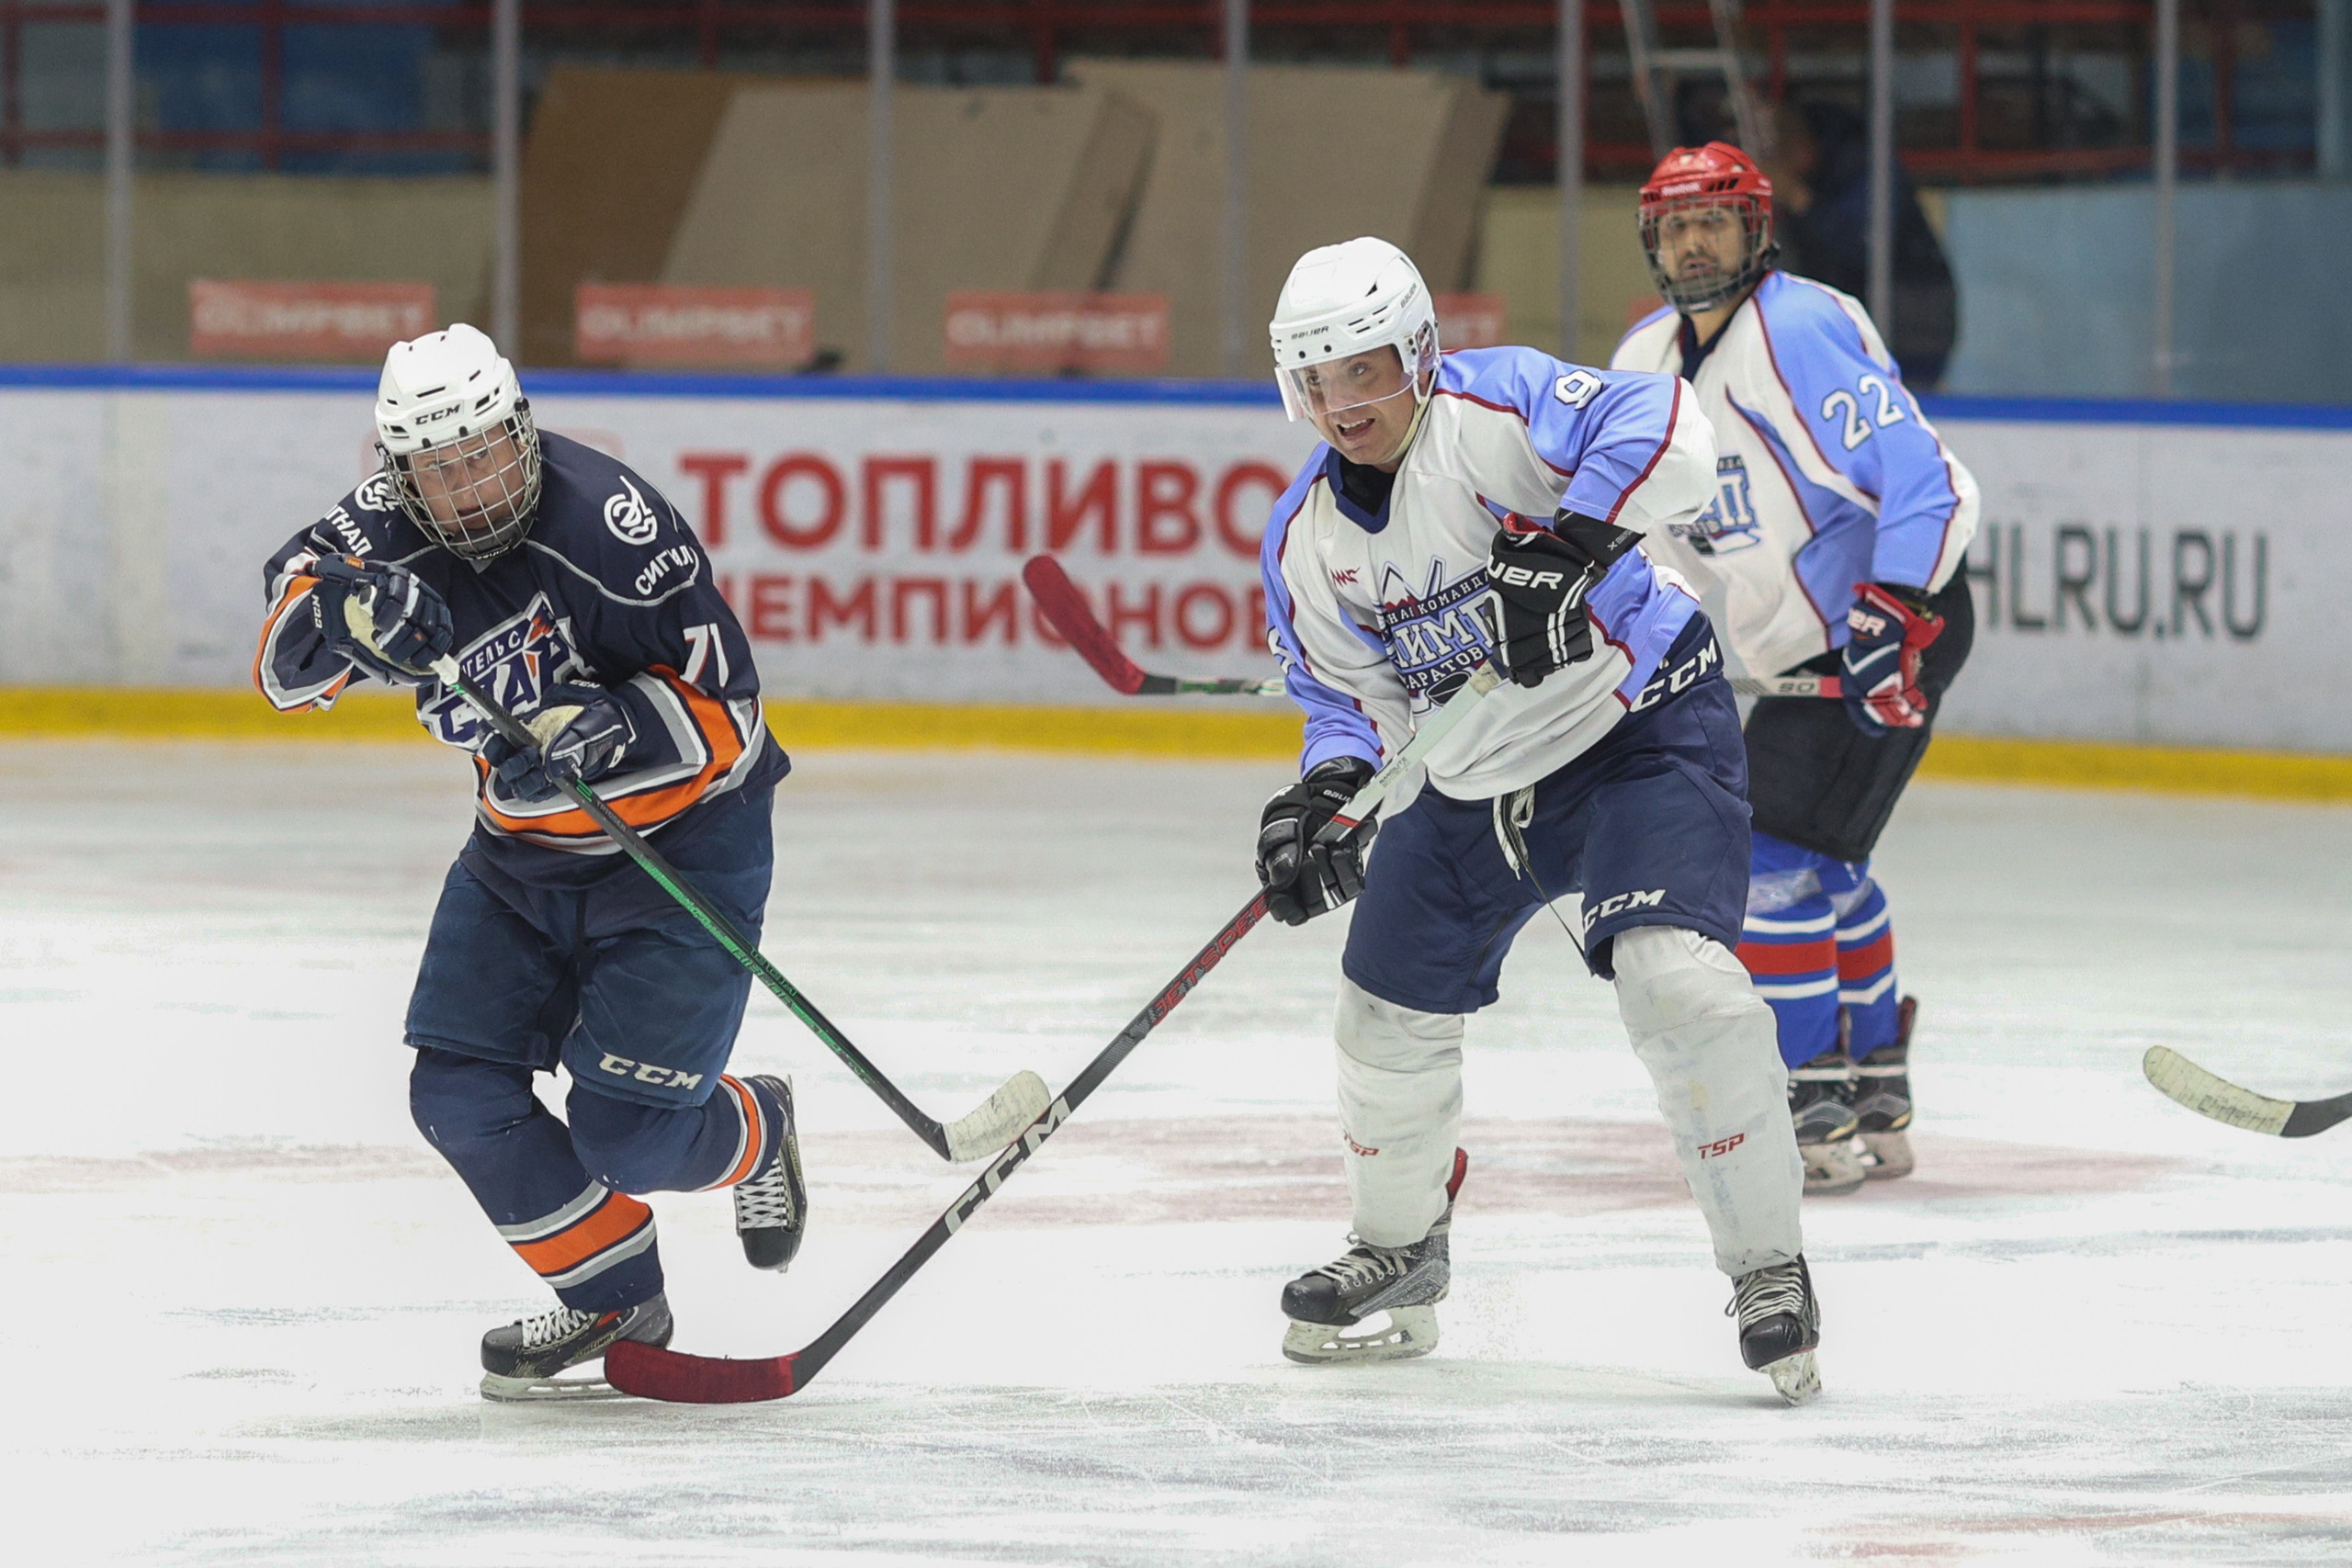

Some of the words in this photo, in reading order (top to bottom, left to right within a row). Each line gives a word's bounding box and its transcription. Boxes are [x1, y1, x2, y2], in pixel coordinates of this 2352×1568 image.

[1291, 326, 1329, 340] BAUER
[415, 404, 461, 425] CCM
[1822, 373, 1905, 452] 22
[678, 452, 1288, 561] ТОПЛИВО
[323, 504, 373, 557] ГНАЛ
[311, 593, 323, 628] CCM
[462, 629, 521, 678] ГЕЛЬС
[679, 623, 729, 687] 71
[1406, 647, 1484, 690] АРАТОВ
[1628, 637, 1718, 713] CCM
[569, 679, 601, 689] CCM
[1583, 889, 1667, 934] CCM
[598, 1052, 704, 1090] CCM
[1697, 1132, 1745, 1159] TSP
